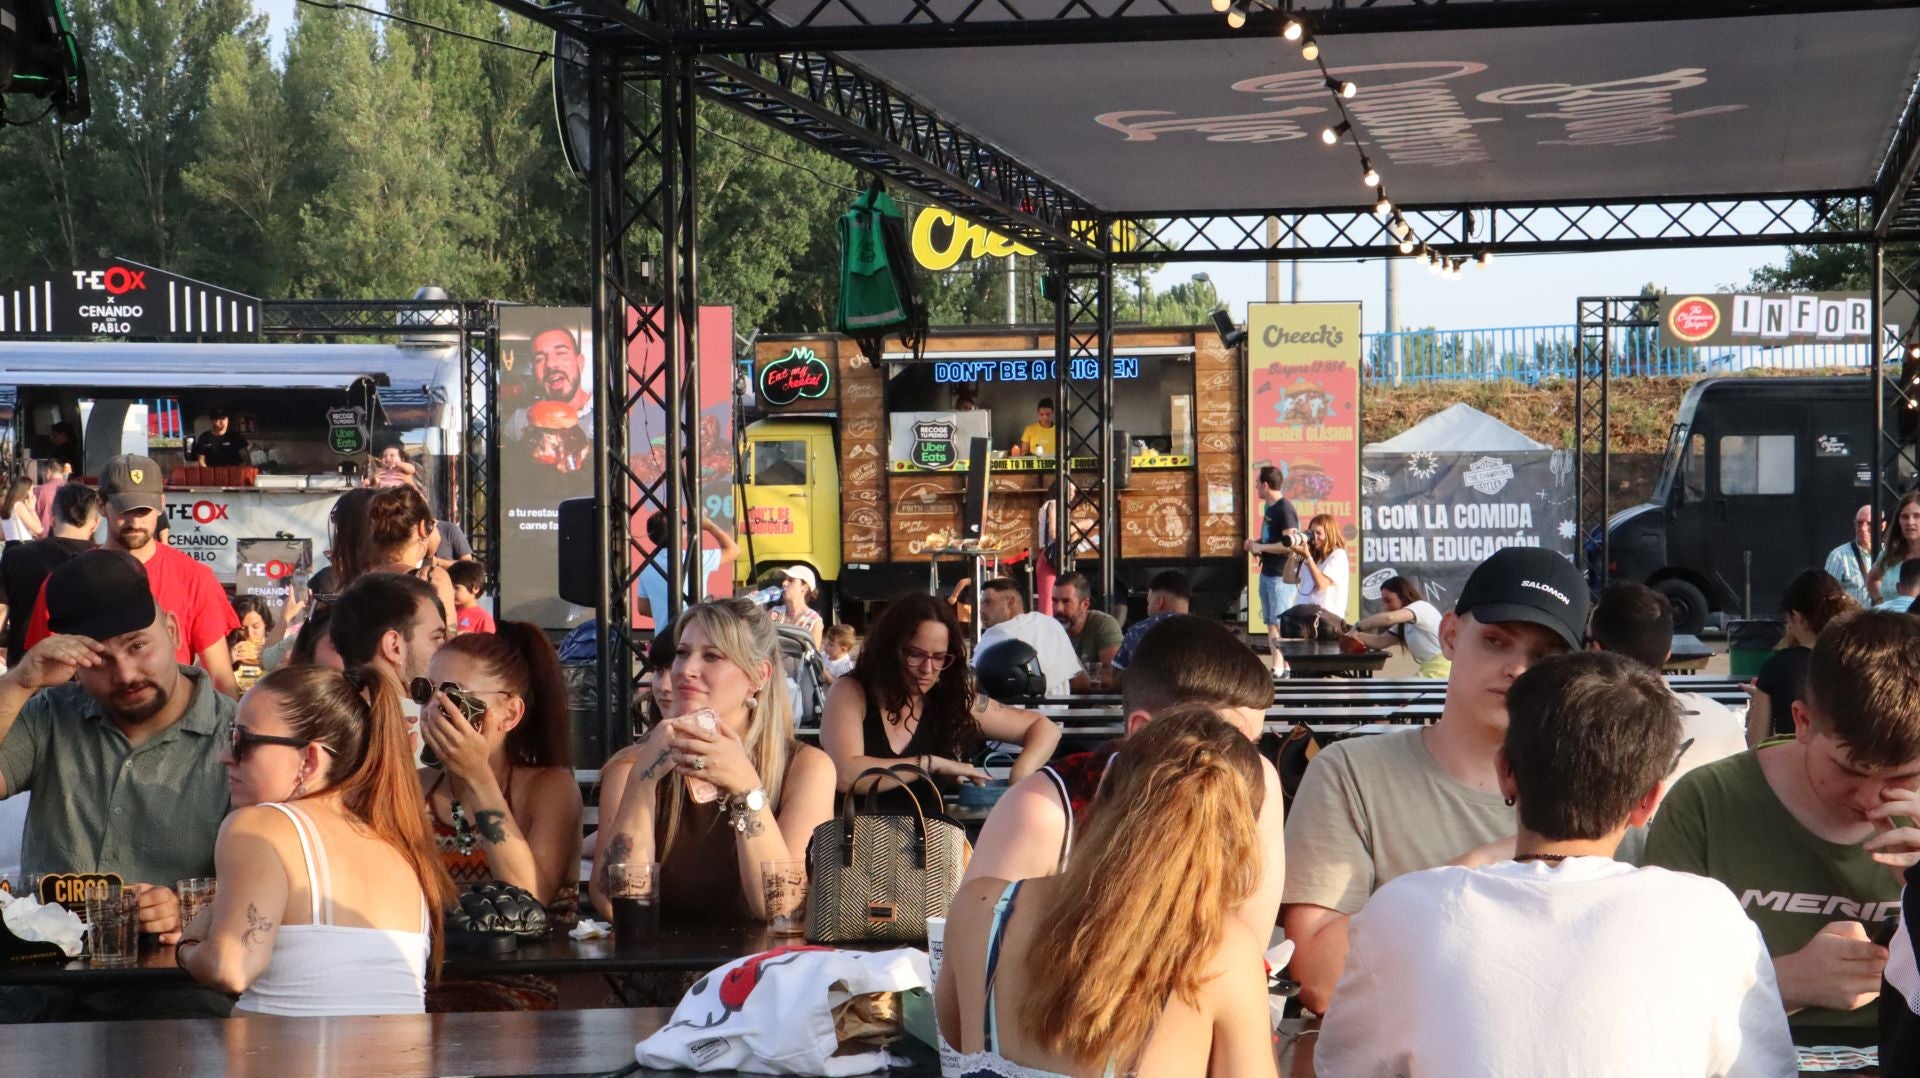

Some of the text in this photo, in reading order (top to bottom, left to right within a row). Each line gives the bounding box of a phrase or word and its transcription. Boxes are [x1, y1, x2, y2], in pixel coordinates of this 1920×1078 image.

[79, 305, 143, 317] CENANDO
[91, 322, 131, 333] PABLO
[1263, 324, 1343, 348] Cheeck's
[935, 362, 996, 382] DON'T
[1000, 361, 1027, 380] BE
[1032, 361, 1047, 379] A
[335, 429, 355, 437] Uber
[1258, 426, 1303, 442] BURGER
[337, 439, 357, 447] Eats
[921, 442, 947, 451] Uber
[921, 452, 947, 462] Eats
[508, 509, 515, 517] a
[516, 507, 527, 517] tu
[1318, 501, 1351, 517] STYLE
[1378, 504, 1418, 530] CON
[1424, 504, 1449, 529] LA
[1454, 503, 1533, 529] COMIDA
[519, 522, 548, 530] carne
[168, 535, 228, 545] CENANDO
[1363, 537, 1427, 563] BUENA
[1521, 580, 1569, 605] SALOMON
[55, 879, 109, 903] CIRCO
